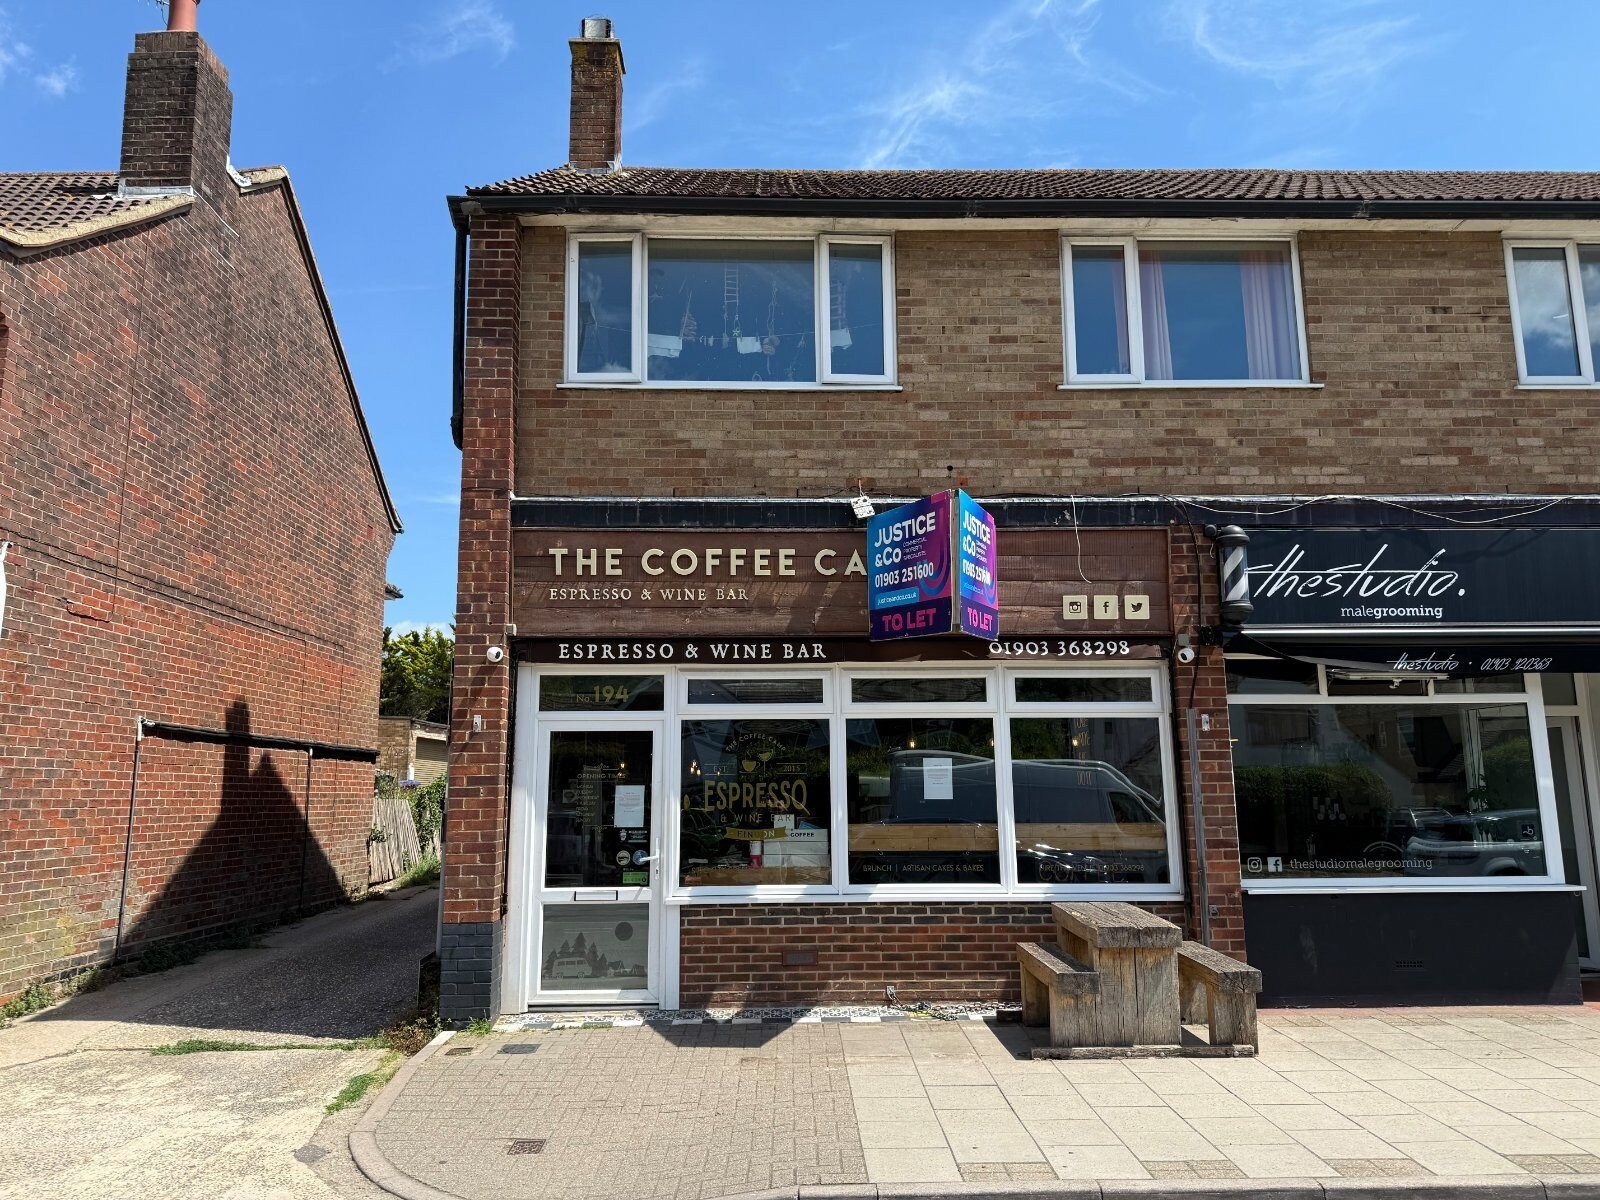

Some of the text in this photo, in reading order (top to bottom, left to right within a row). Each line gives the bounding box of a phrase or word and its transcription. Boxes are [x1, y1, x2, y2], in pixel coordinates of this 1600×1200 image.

[874, 511, 936, 547] JUSTICE
[963, 510, 991, 545] JUSTICE
[549, 548, 868, 576] THE COFFEE CA
[875, 562, 934, 588] 01903 251600
[550, 588, 749, 601] ESPRESSO & WINE BAR
[882, 608, 937, 631] TO LET
[967, 607, 993, 631] TO LET
[1341, 605, 1443, 619] malegrooming
[559, 644, 827, 660] ESPRESSO & WINE BAR
[989, 640, 1130, 656] 01903 368298
[593, 685, 629, 703] 194
[725, 739, 738, 752] THE
[738, 733, 766, 742] COFFEE
[704, 779, 808, 812] ESPRESSO
[720, 814, 791, 823] & WINE BAR
[737, 830, 775, 839] FINON
[862, 864, 984, 873] BRUNCH ARTISAN CAKES & BAKES
[1289, 858, 1433, 870] thestudiomalegrooming
